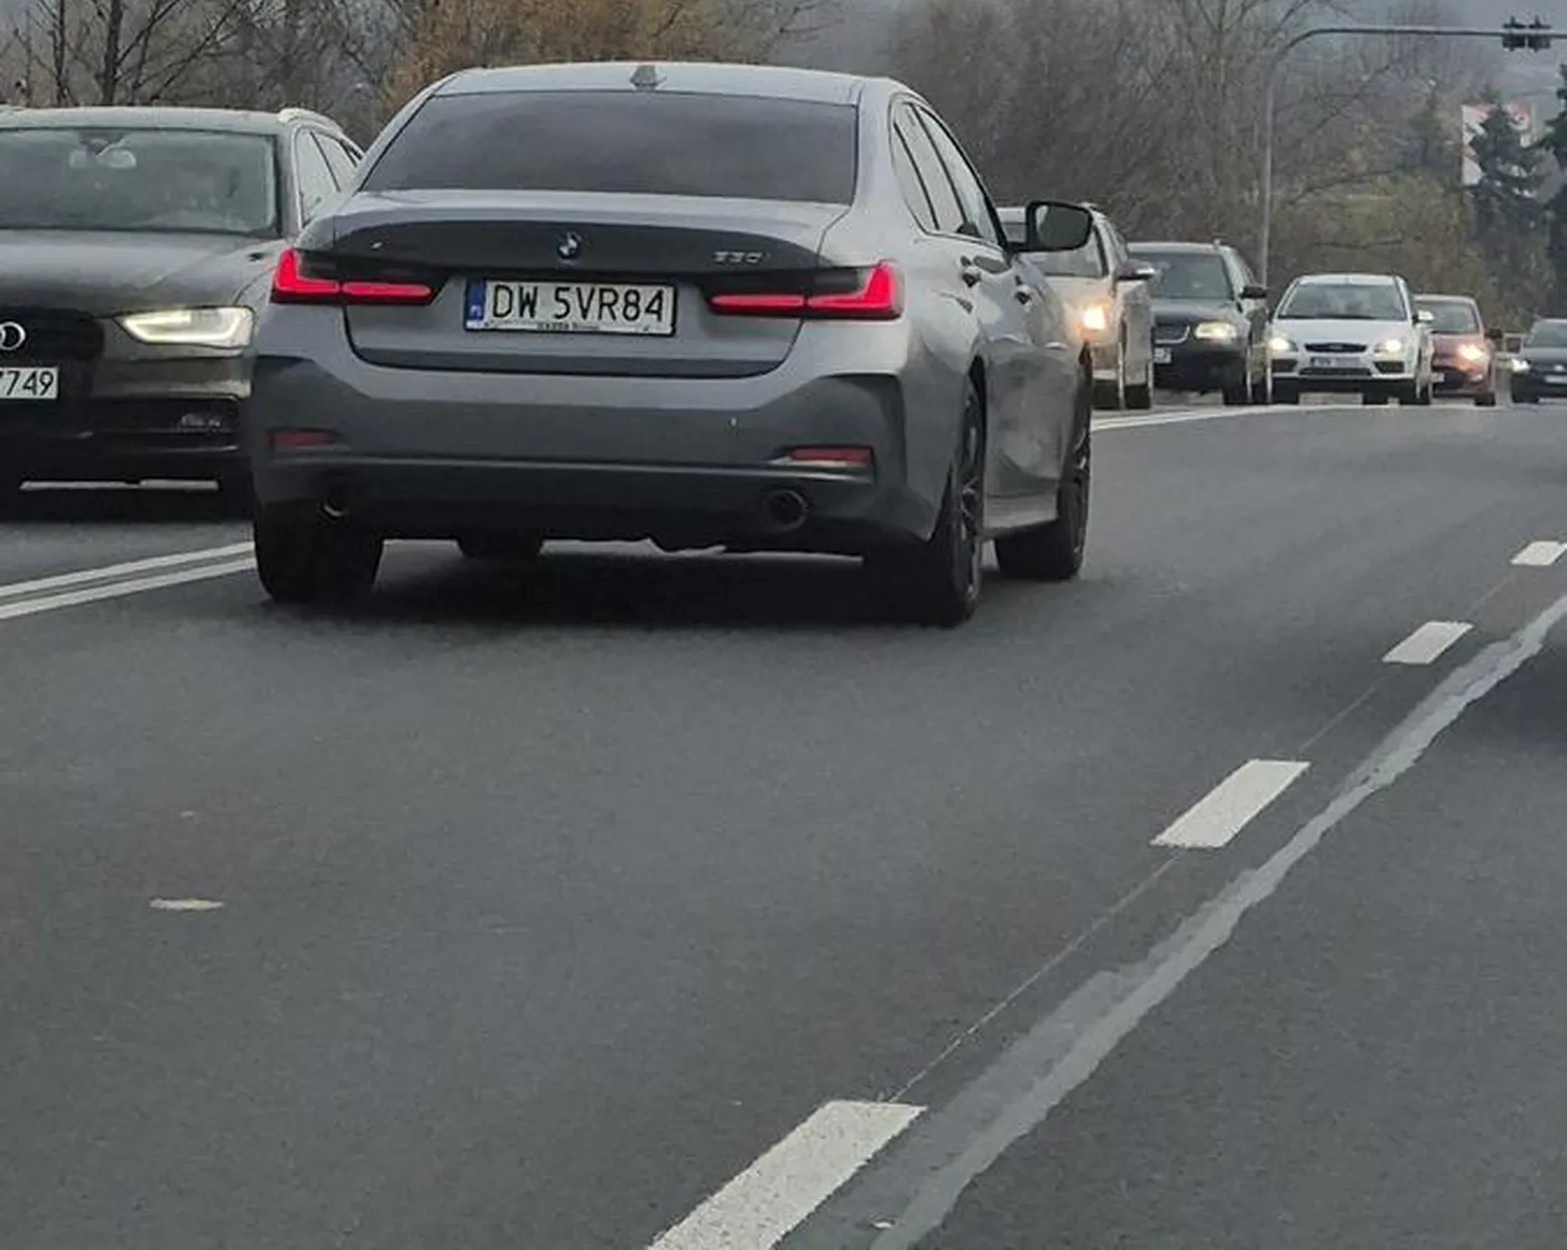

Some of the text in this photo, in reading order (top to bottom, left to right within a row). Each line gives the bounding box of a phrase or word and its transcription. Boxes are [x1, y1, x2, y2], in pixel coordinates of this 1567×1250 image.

[493, 284, 665, 322] DW 5VR84
[0, 370, 54, 396] 749
